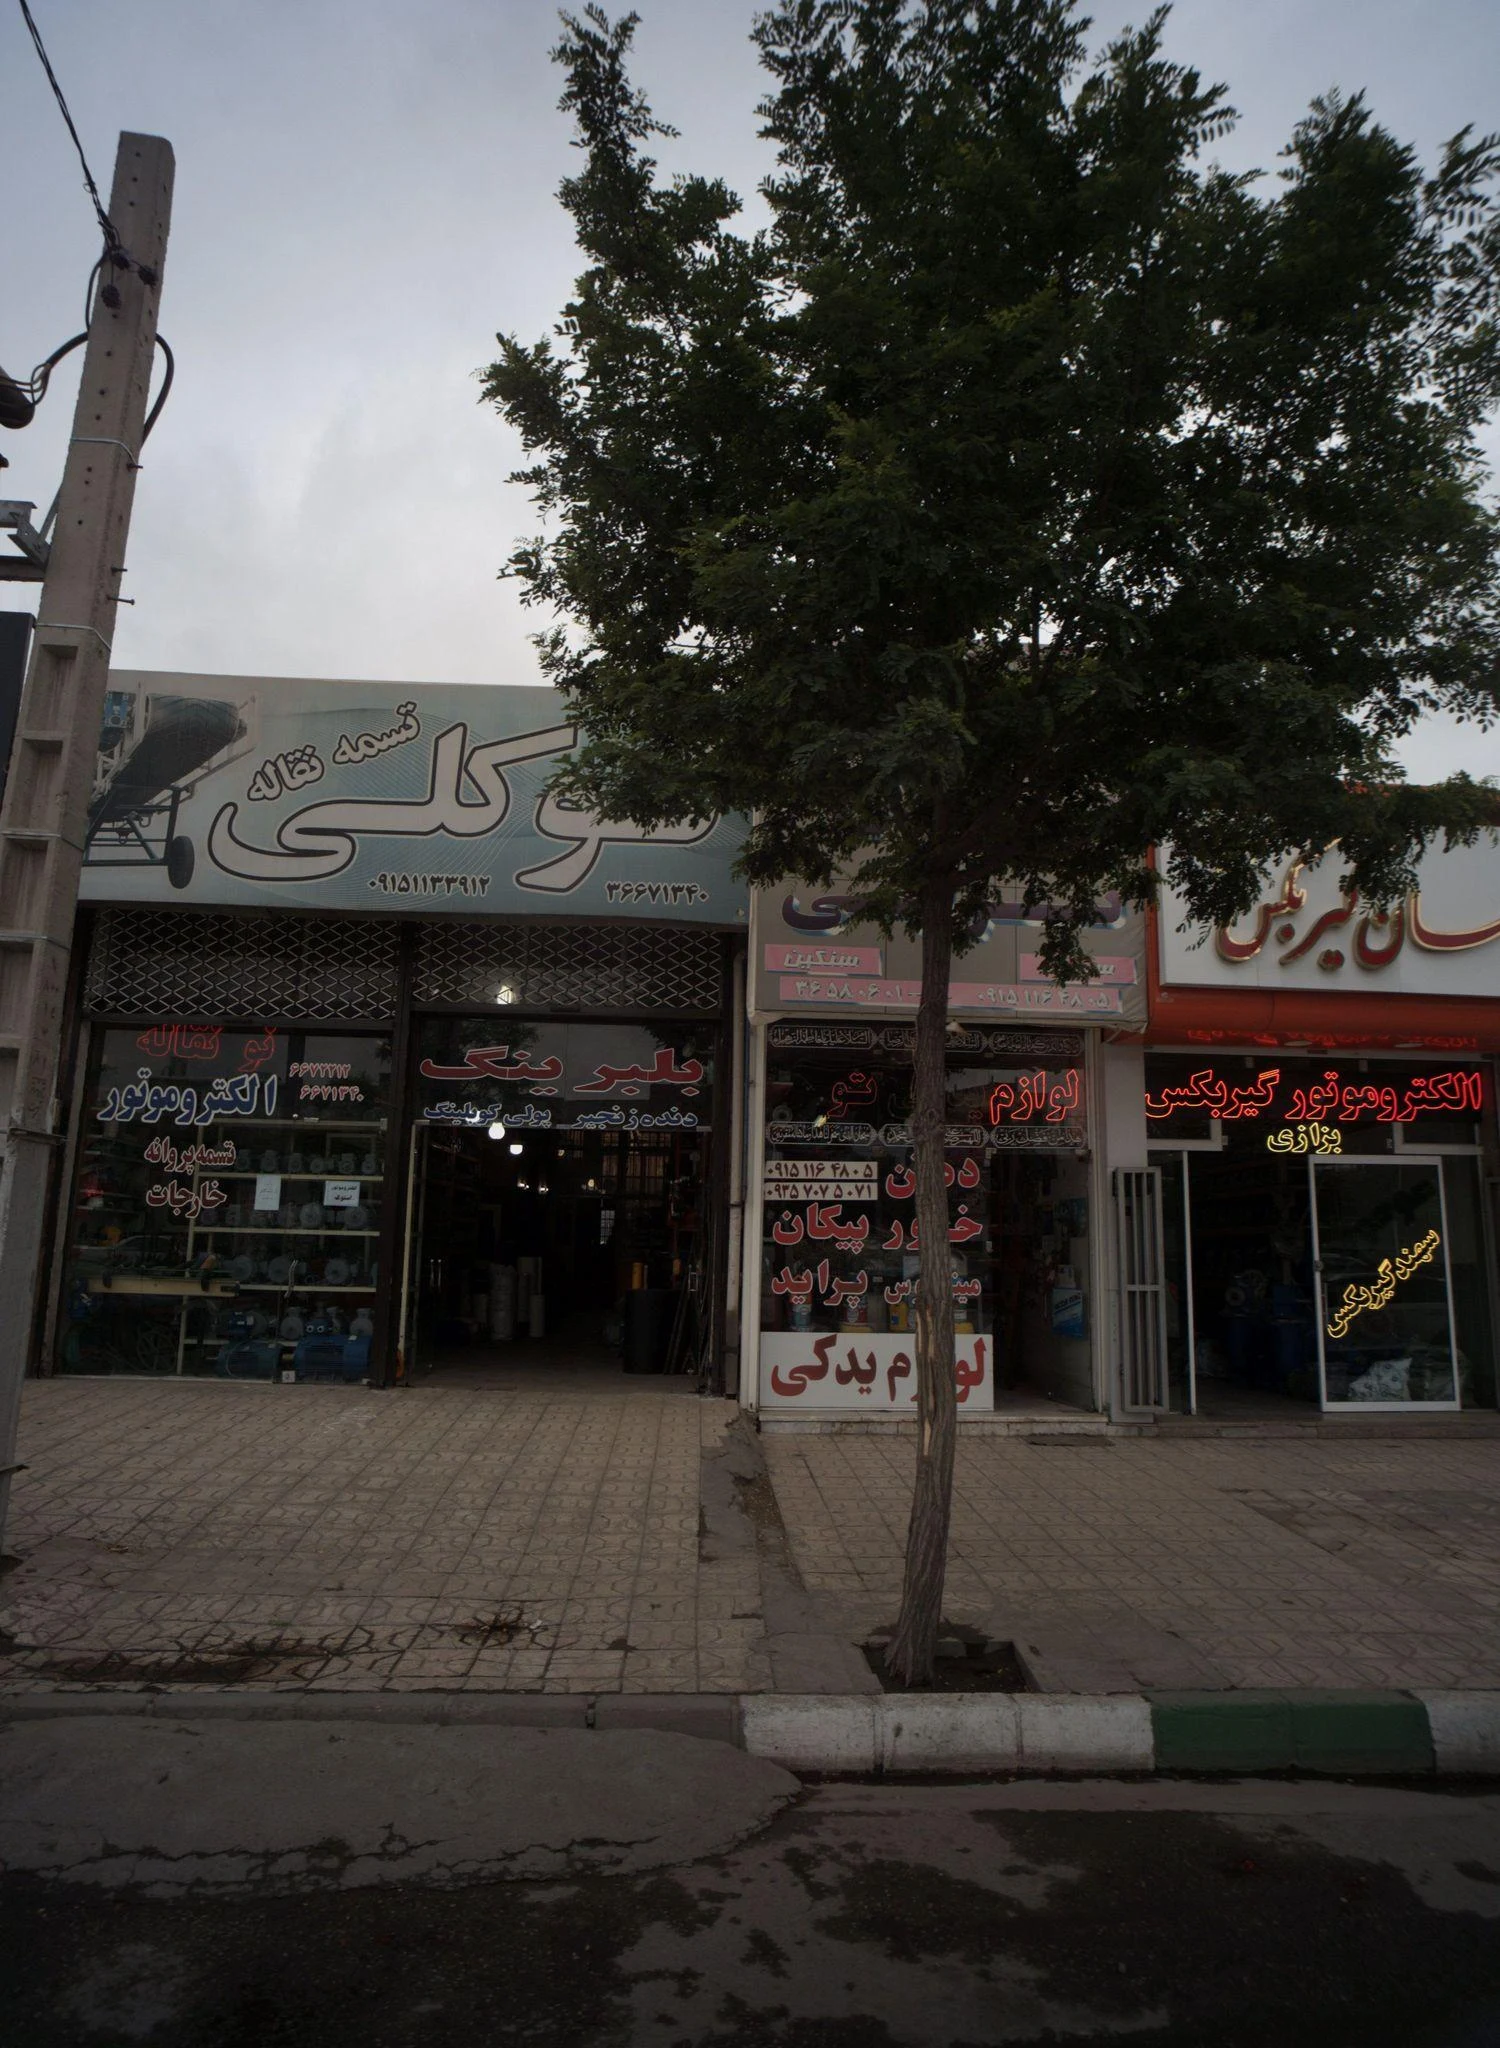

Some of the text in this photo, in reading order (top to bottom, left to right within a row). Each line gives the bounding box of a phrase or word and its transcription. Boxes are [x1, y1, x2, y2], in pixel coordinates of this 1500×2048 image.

[246, 701, 421, 801] تسمه نقاله
[369, 873, 490, 896] ۰۹۱۵۱۱۳۳۹۱۲
[606, 881, 709, 903] ۳۶۶۷۱۳۴۰
[97, 1067, 278, 1126] الکتروموتور
[300, 1084, 365, 1102] ۶۶۷۱۳۴۰
[503, 1103, 552, 1128] پولی
[988, 1068, 1080, 1126] لوازم
[1144, 1068, 1281, 1120] گیربکس
[571, 1104, 699, 1130] دنده زنجیر
[1266, 1121, 1343, 1154] بزازی
[144, 1135, 237, 1176] تسمه پروانه
[145, 1179, 228, 1219] خارجات
[772, 1201, 870, 1255] پیکان
[770, 1257, 869, 1310] پراید
[1326, 1256, 1400, 1339] گیربکس
[771, 1333, 877, 1397] یدکی
